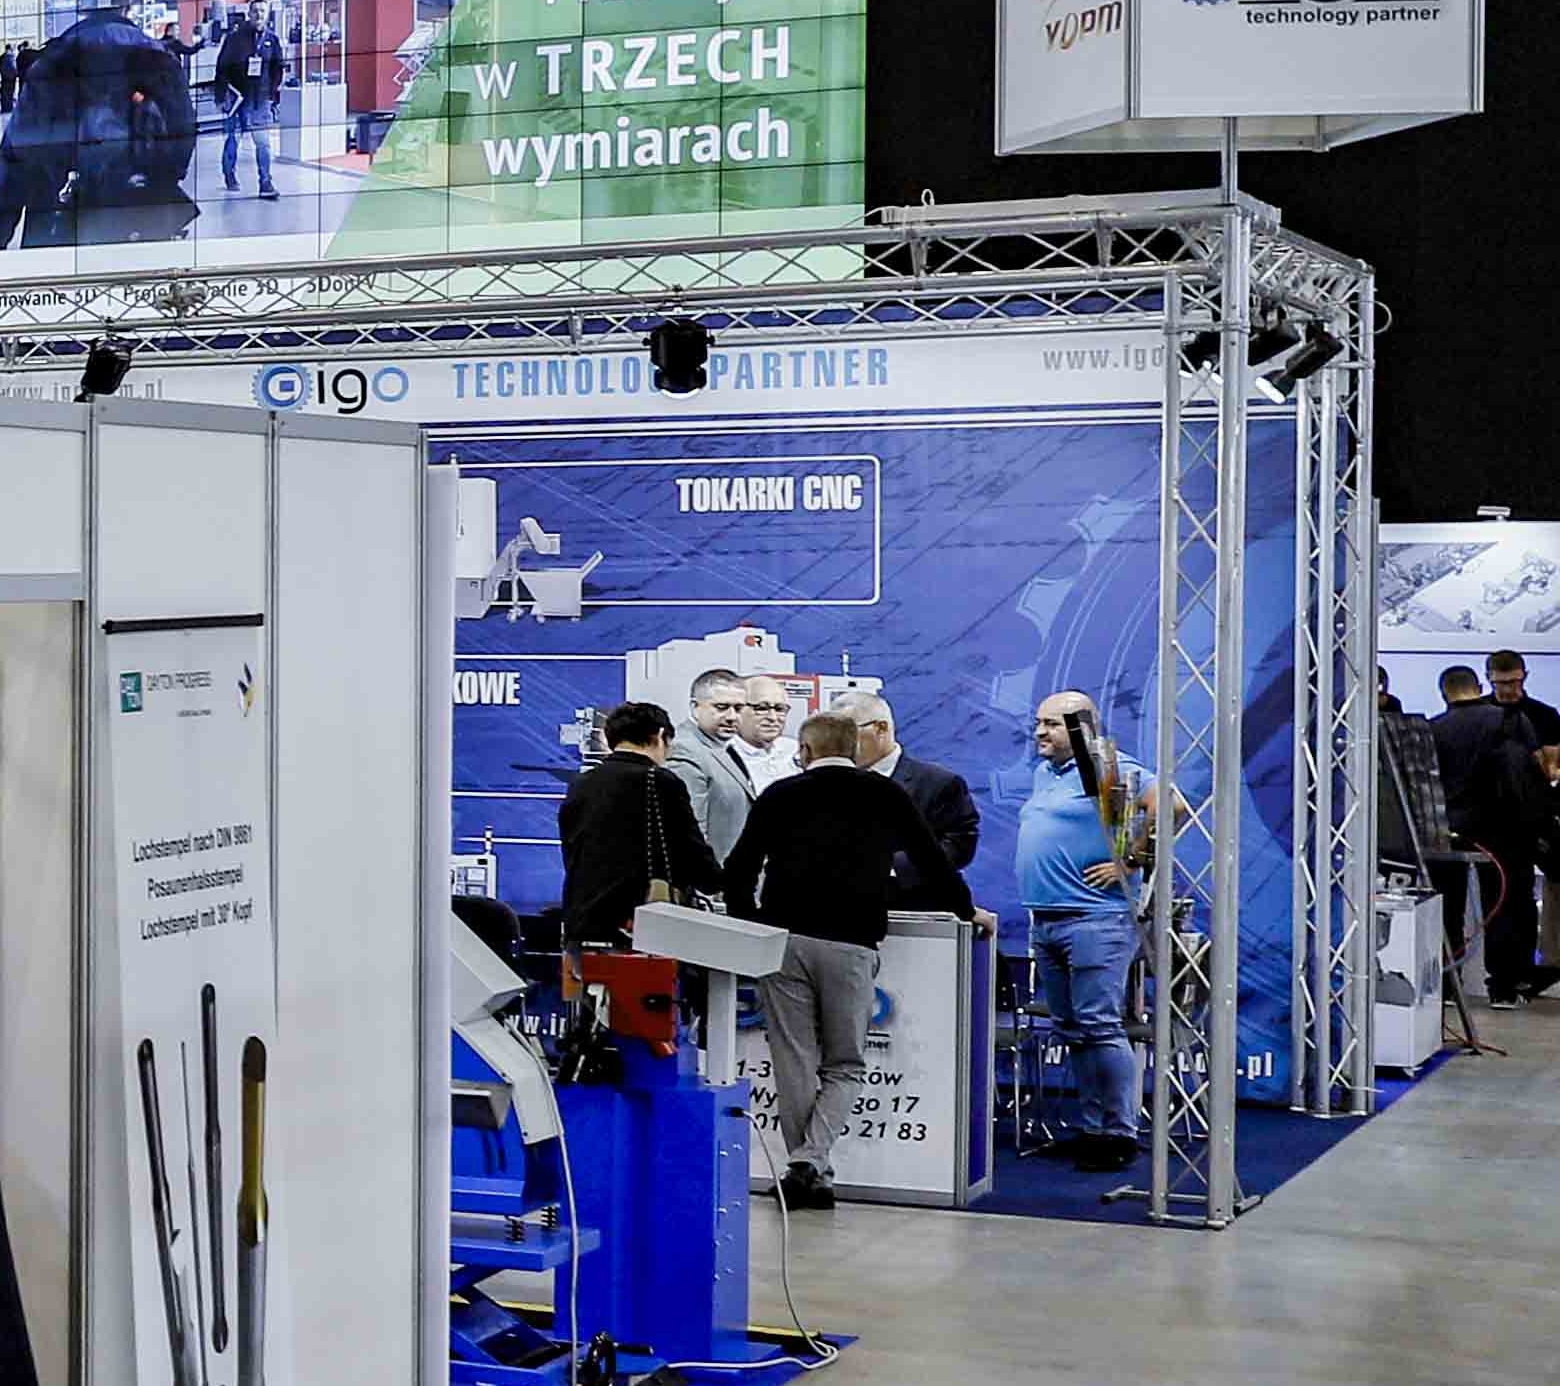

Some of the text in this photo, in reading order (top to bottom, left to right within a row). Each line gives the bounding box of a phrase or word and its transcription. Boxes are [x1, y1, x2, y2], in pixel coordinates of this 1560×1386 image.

[1246, 5, 1441, 27] technology partner
[472, 25, 791, 102] w TRZECH
[482, 107, 791, 188] wymiarach
[451, 354, 660, 399] TECHNOLO
[709, 347, 890, 391] PARTNER
[675, 473, 864, 513] TOKARKI CNC
[891, 1096, 921, 1114] 17
[858, 1120, 928, 1142] 21 83
